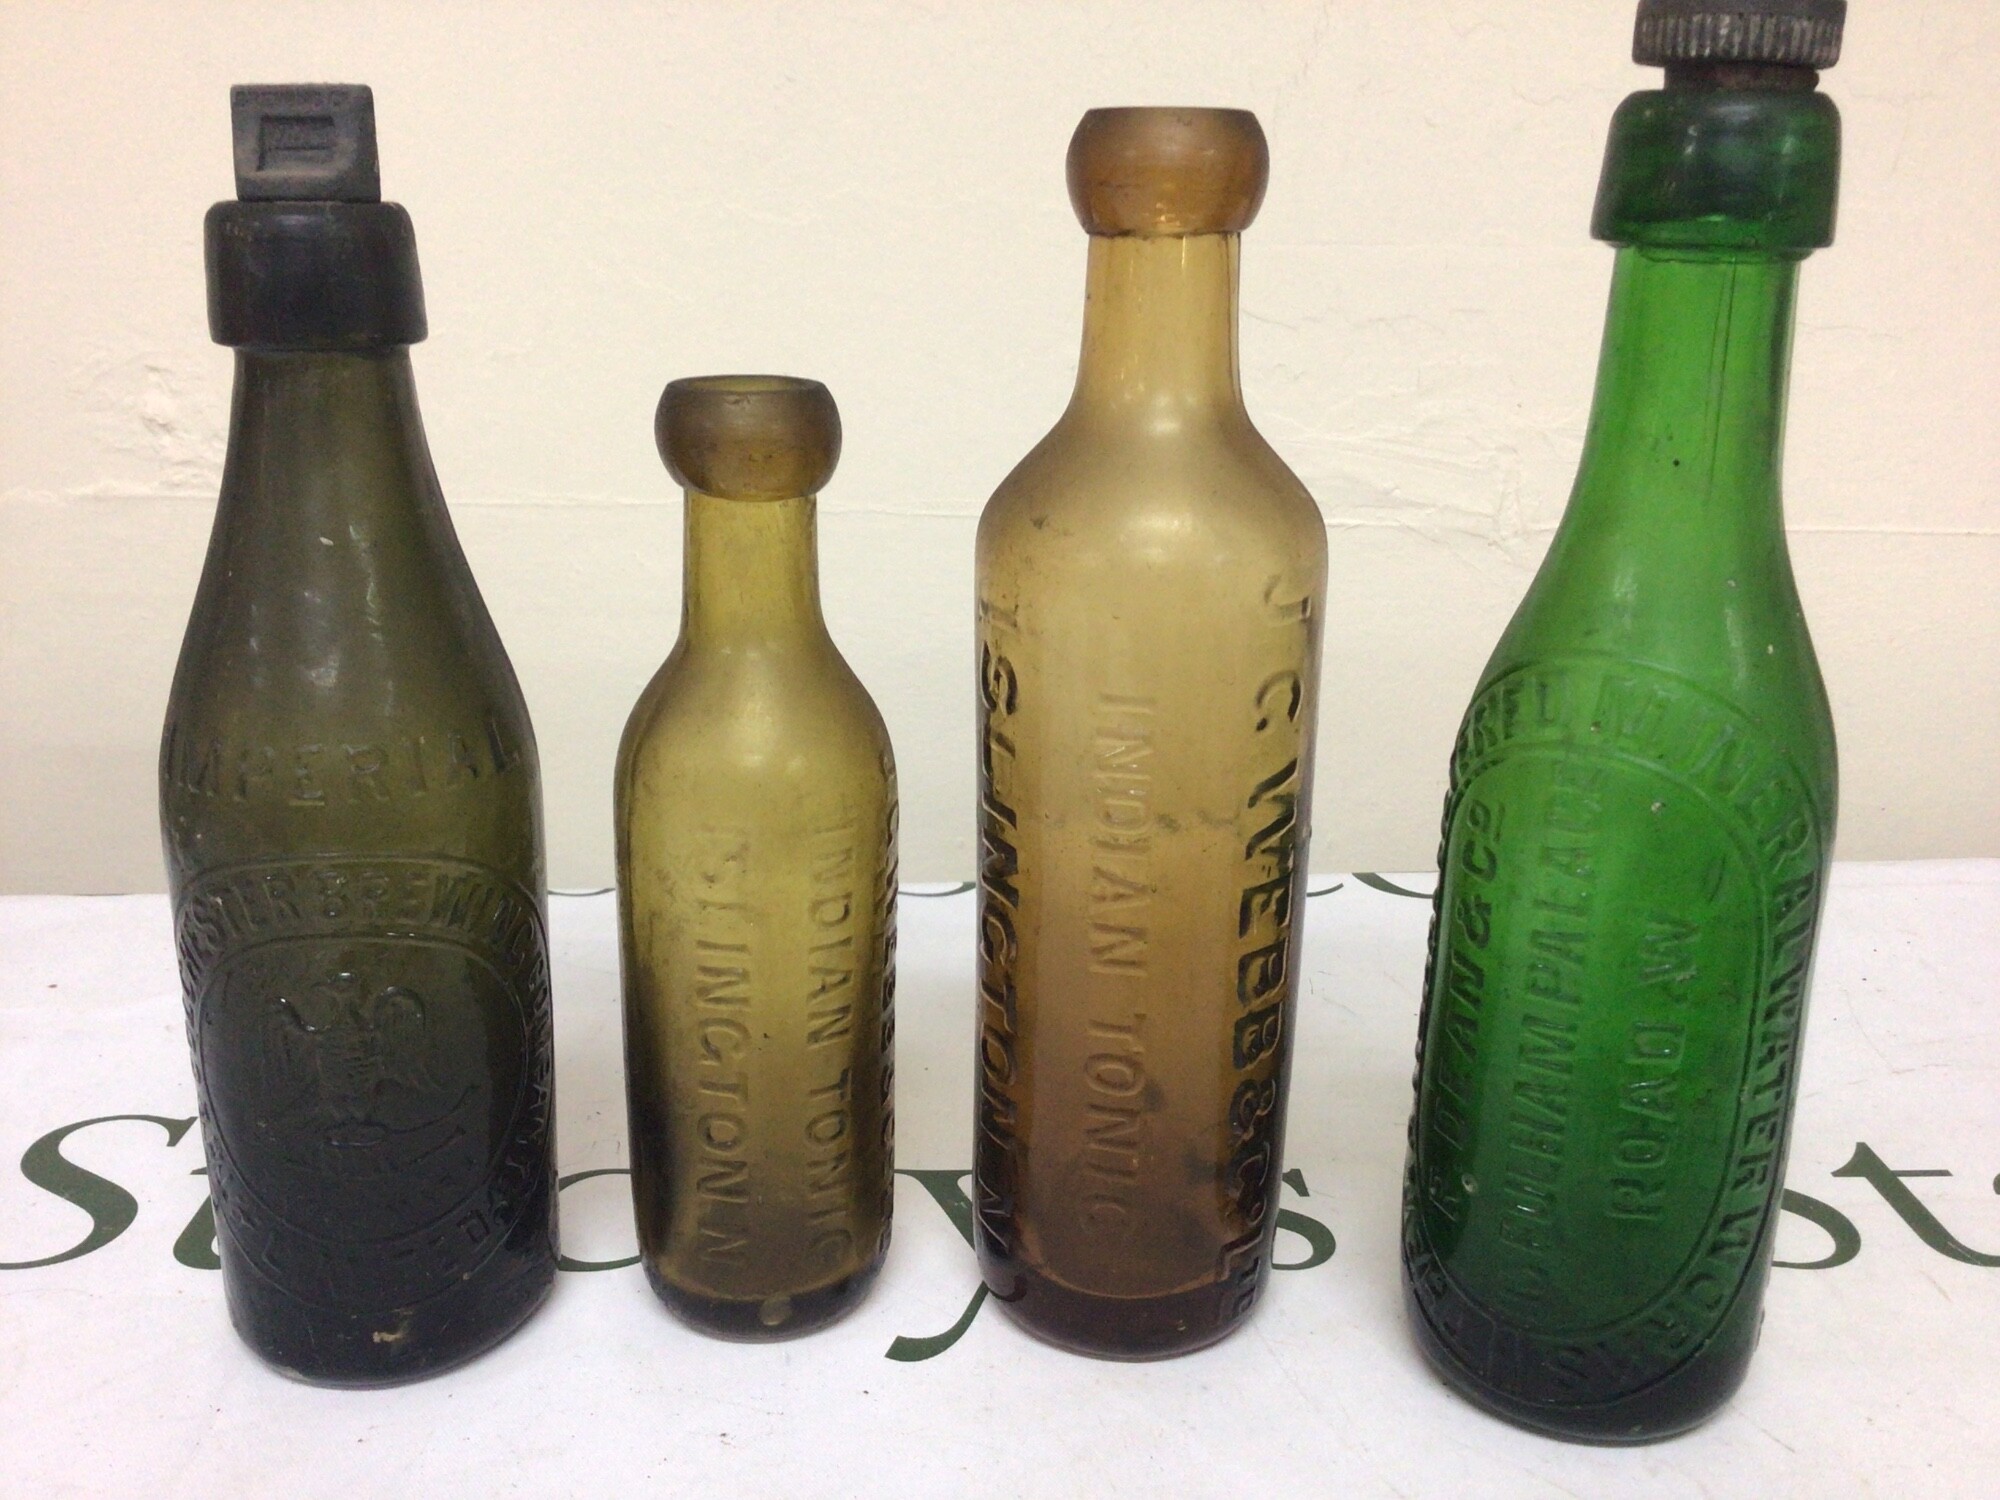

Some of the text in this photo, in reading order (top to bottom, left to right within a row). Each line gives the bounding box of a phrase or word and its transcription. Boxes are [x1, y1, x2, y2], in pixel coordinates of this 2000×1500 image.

[696, 823, 752, 1206] ISLINGTON
[806, 822, 858, 1268] INDIAN TONIC
[1081, 692, 1158, 1236] INDIAN TONIC
[1731, 961, 1805, 1192] WATER
